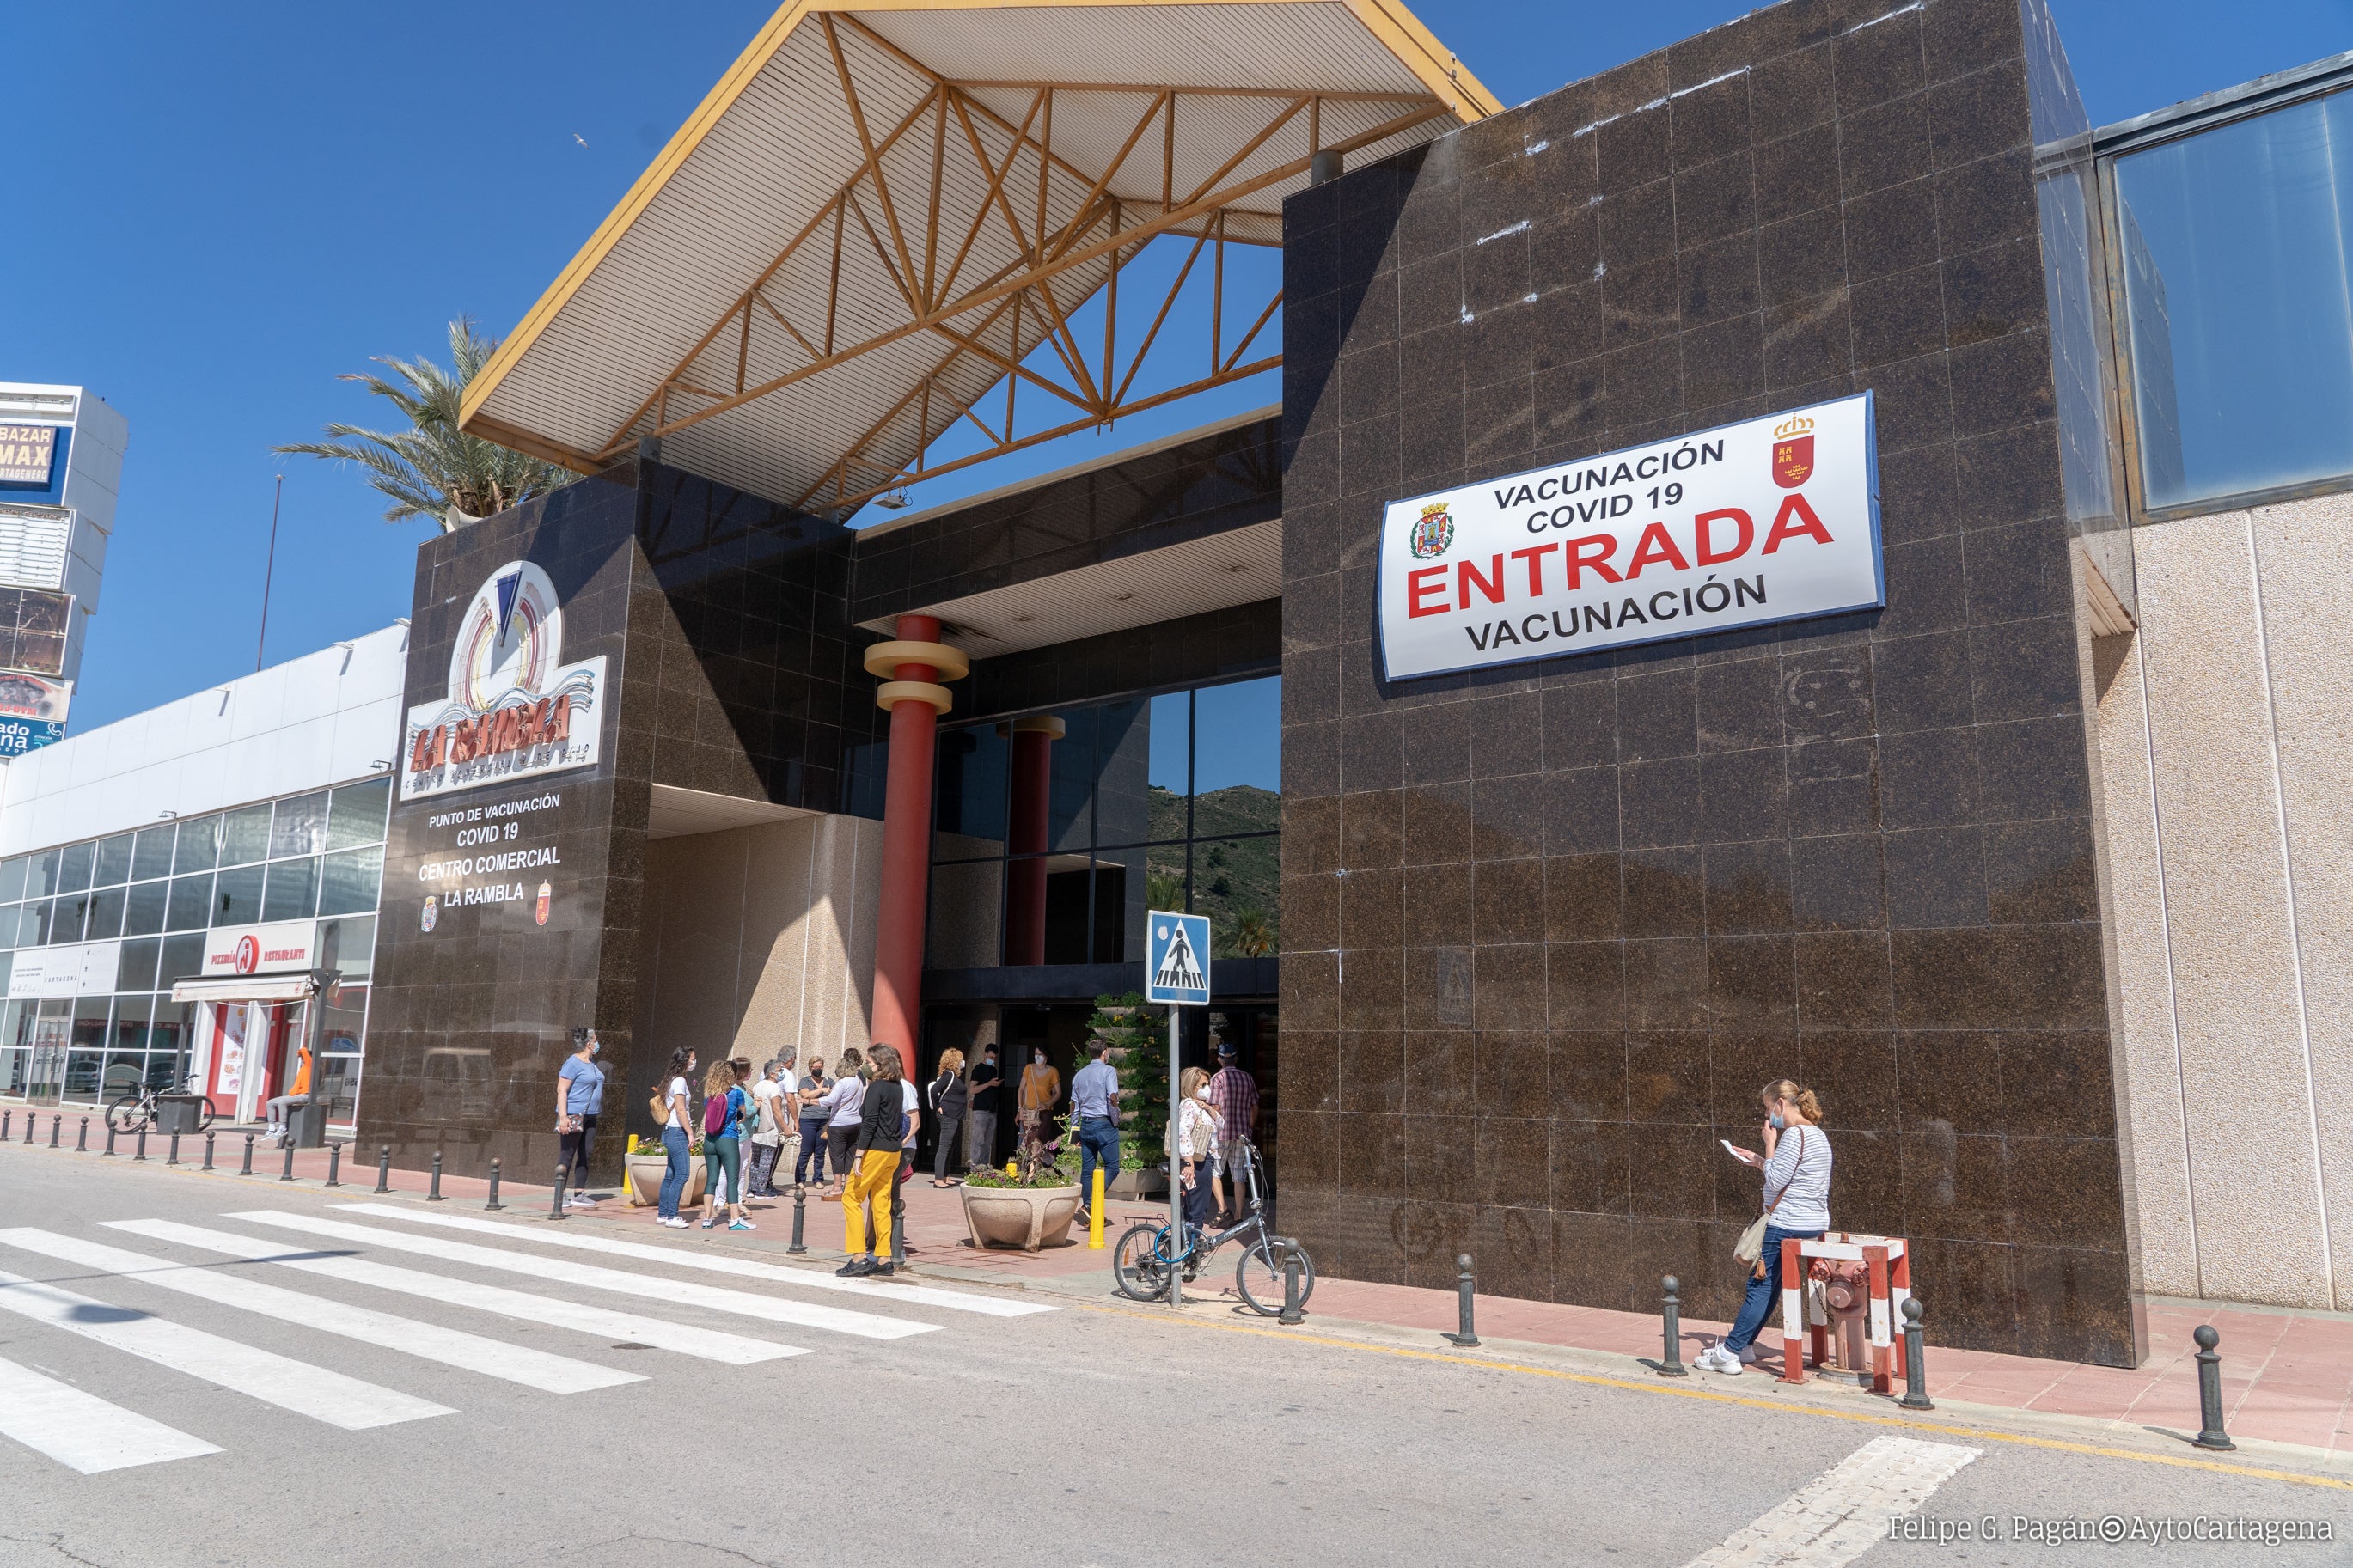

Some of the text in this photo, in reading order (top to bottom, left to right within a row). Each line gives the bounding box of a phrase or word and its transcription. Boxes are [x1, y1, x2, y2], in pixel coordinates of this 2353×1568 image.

[0, 427, 51, 442] BAZAR
[1494, 439, 1725, 509] VACUNACIÓN
[1526, 481, 1684, 534] COVID 19
[1408, 492, 1835, 619] ENTRADA
[1465, 574, 1768, 652] VACUNACIÓN
[410, 694, 571, 772] LA RAMBLA
[429, 793, 560, 828] PUNTO DE VACUNACIÓN
[457, 822, 519, 847] COVID 19
[419, 847, 561, 882] CENTRO COMERCIAL
[444, 882, 524, 907] LA RAMBLA
[263, 948, 306, 962] RESTAURANTE
